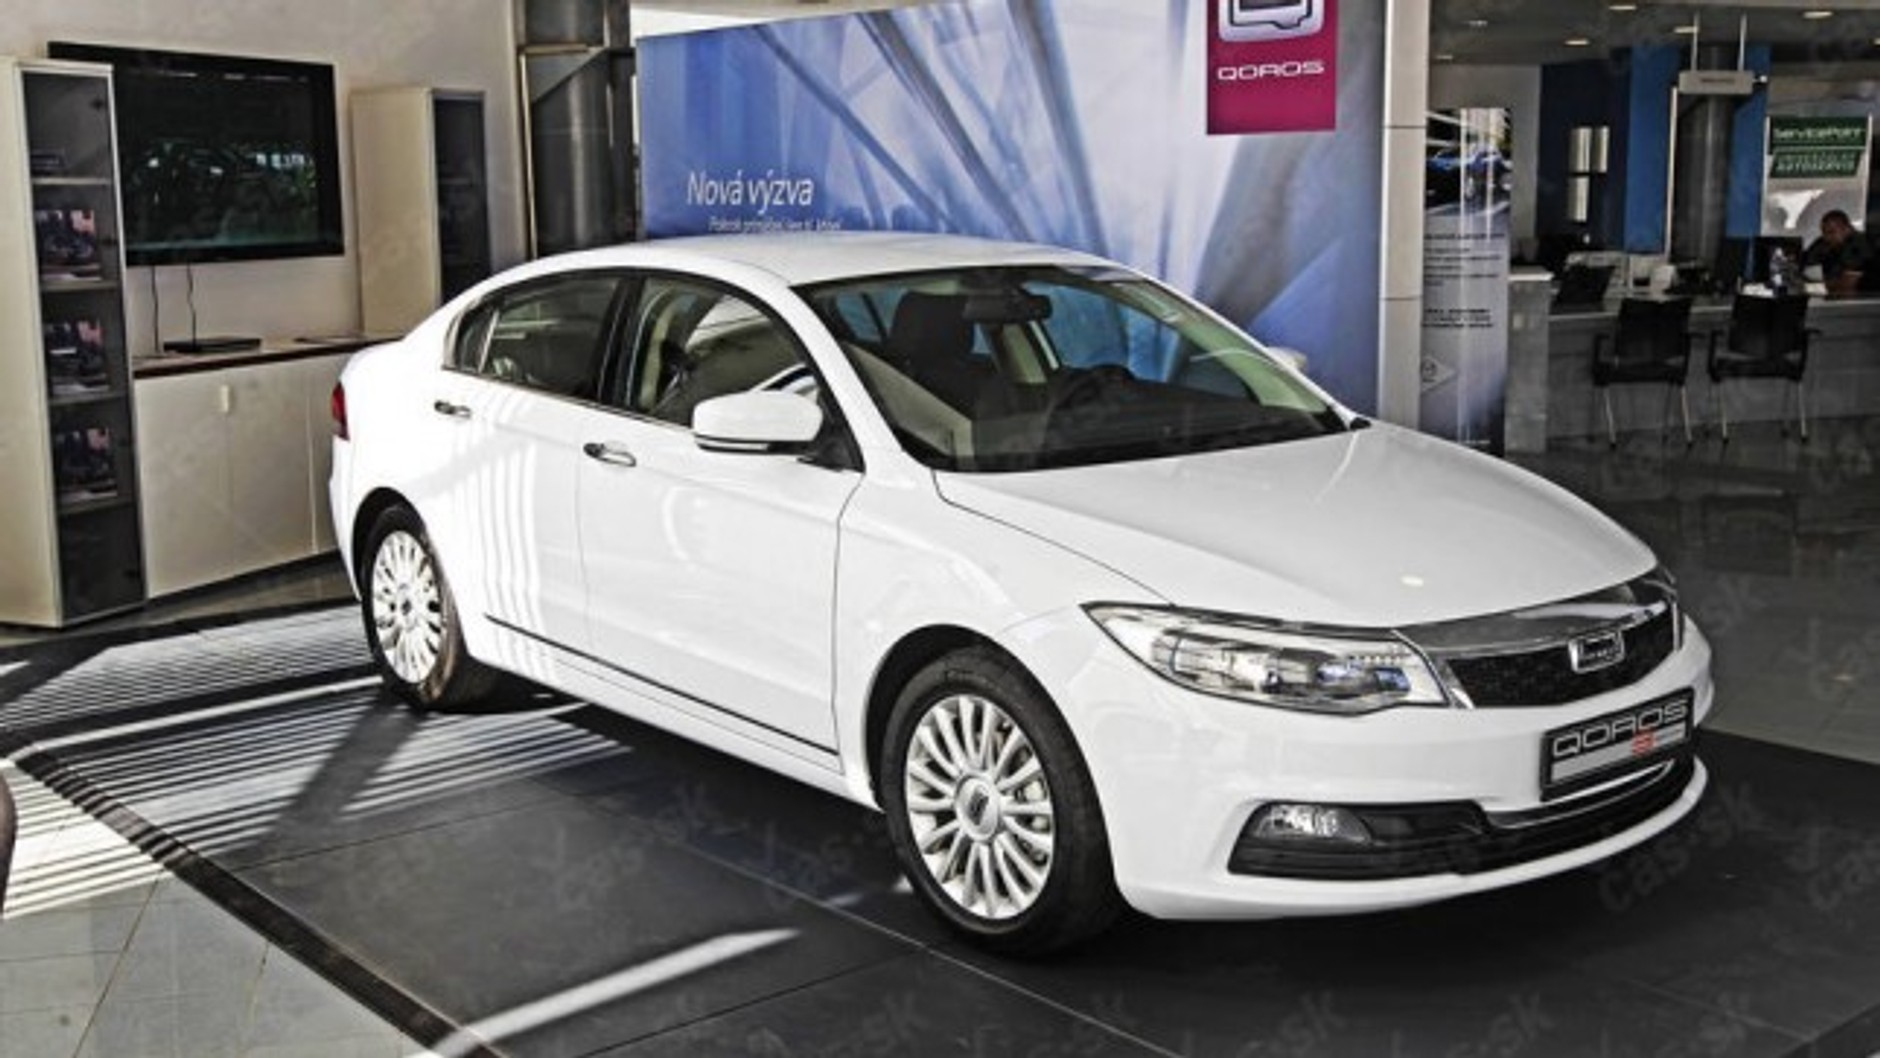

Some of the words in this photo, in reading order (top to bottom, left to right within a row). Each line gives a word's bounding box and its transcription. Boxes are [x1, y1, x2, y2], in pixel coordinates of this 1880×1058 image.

[1217, 60, 1324, 81] QOROS
[687, 169, 744, 206] Nová
[748, 169, 815, 215] výzva
[1553, 700, 1688, 758] QOROS
